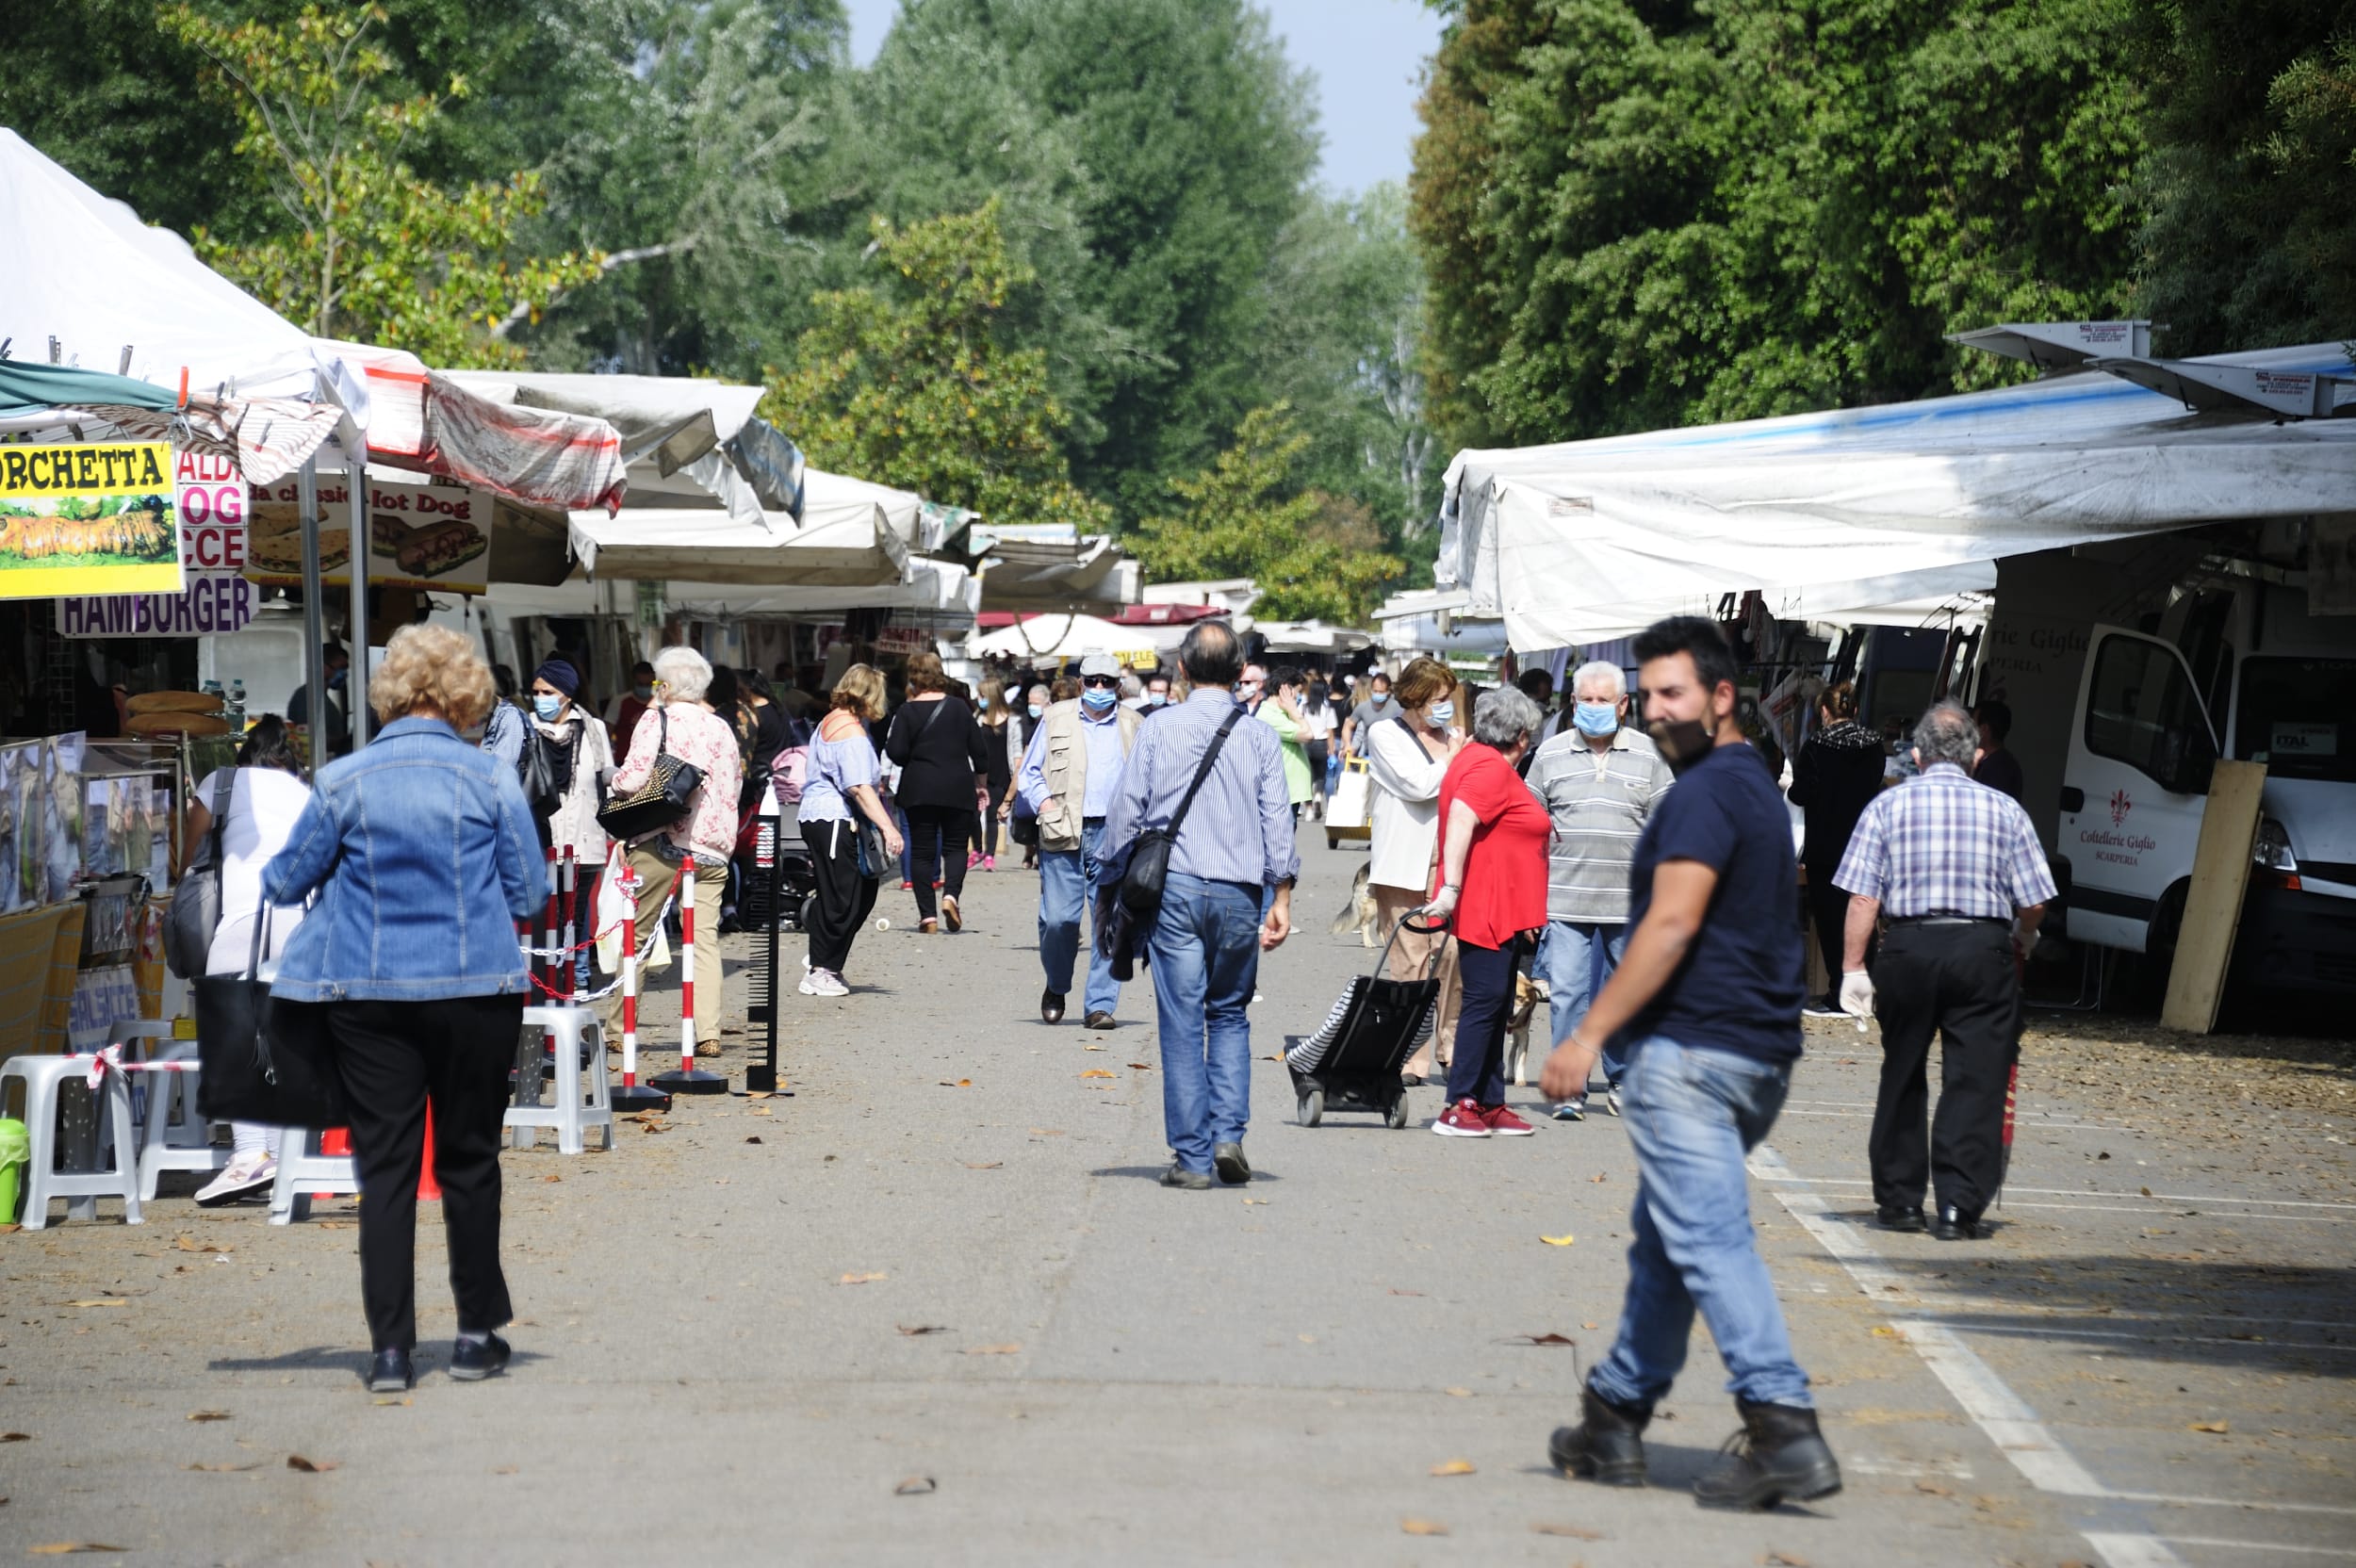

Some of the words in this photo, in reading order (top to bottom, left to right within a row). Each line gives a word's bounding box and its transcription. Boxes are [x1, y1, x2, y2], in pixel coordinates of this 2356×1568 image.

[0, 448, 163, 491] RCHETTA
[416, 493, 470, 520] Dog
[64, 578, 251, 634] HAMBURGER
[2080, 830, 2125, 847] Coltellerie
[2127, 835, 2156, 855] Giglio
[2095, 851, 2138, 867] SCARPERIA
